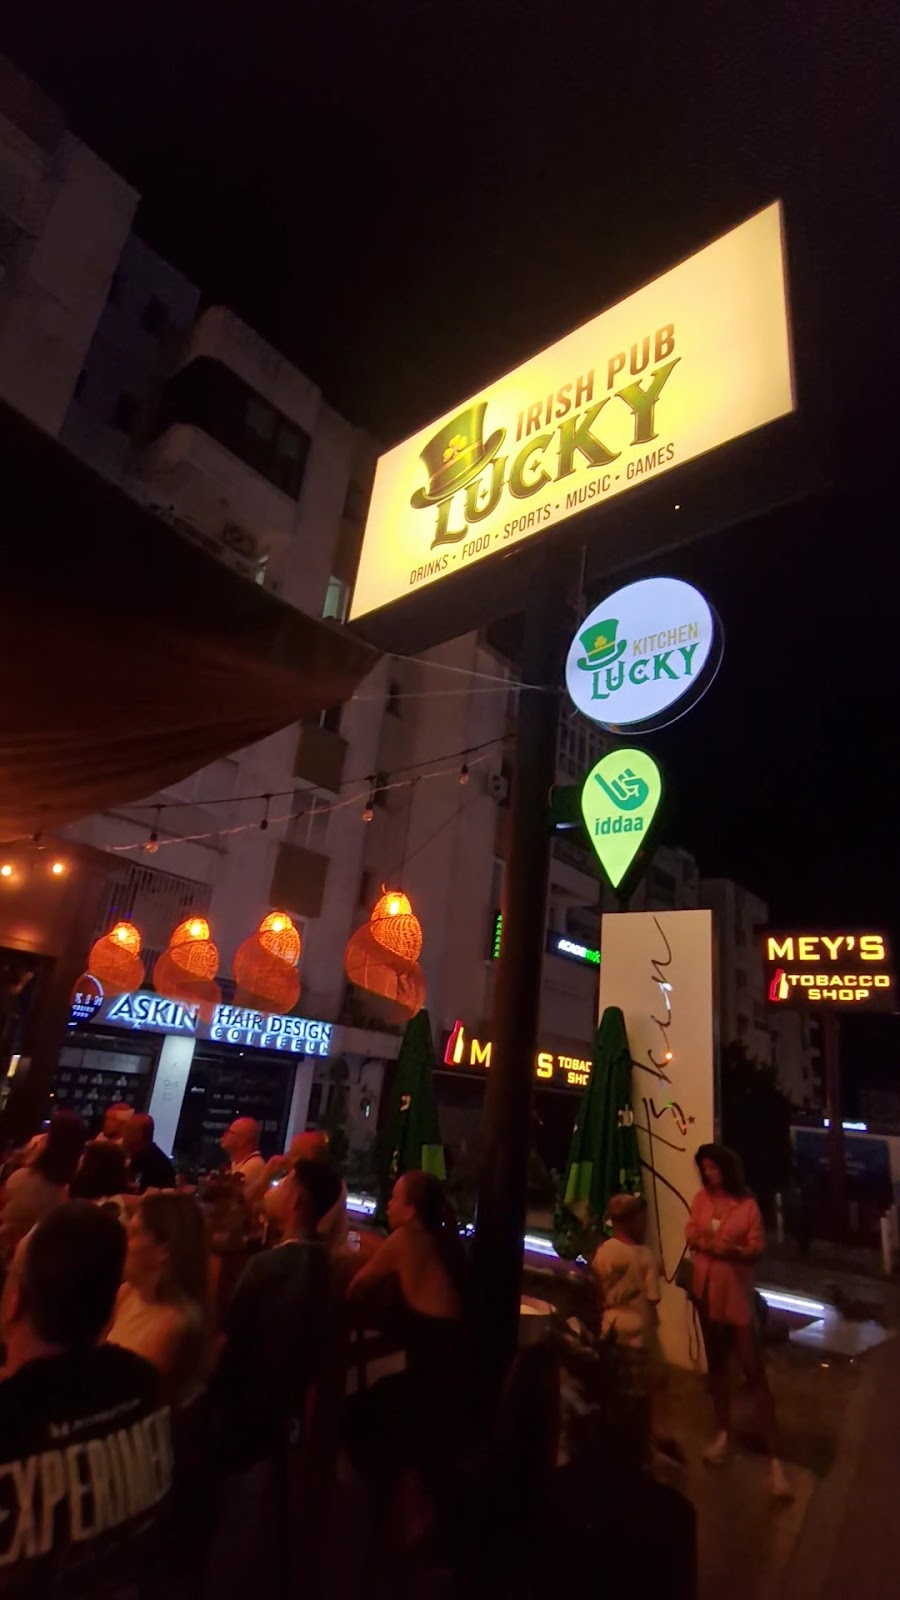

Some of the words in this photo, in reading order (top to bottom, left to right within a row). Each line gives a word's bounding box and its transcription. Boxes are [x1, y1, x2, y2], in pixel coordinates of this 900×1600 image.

[516, 369, 594, 442] IRISH
[607, 323, 676, 390] PUB
[430, 357, 682, 550] LUCKY
[409, 554, 449, 586] DRINKS
[461, 533, 491, 560] FOOD
[503, 503, 552, 540] SPORTS
[565, 474, 612, 510] MUSIC
[626, 443, 676, 480] GAMES
[632, 621, 699, 657] KITCHEN
[590, 642, 700, 700] LUCKY
[594, 816, 644, 836] iddaa
[768, 935, 885, 960] MEY'S
[787, 975, 890, 987] TOBACCO
[808, 989, 869, 1000] SHOP
[212, 1004, 262, 1031] HAIR
[267, 1014, 331, 1043] DESIGN
[557, 1056, 592, 1072] TOBAC
